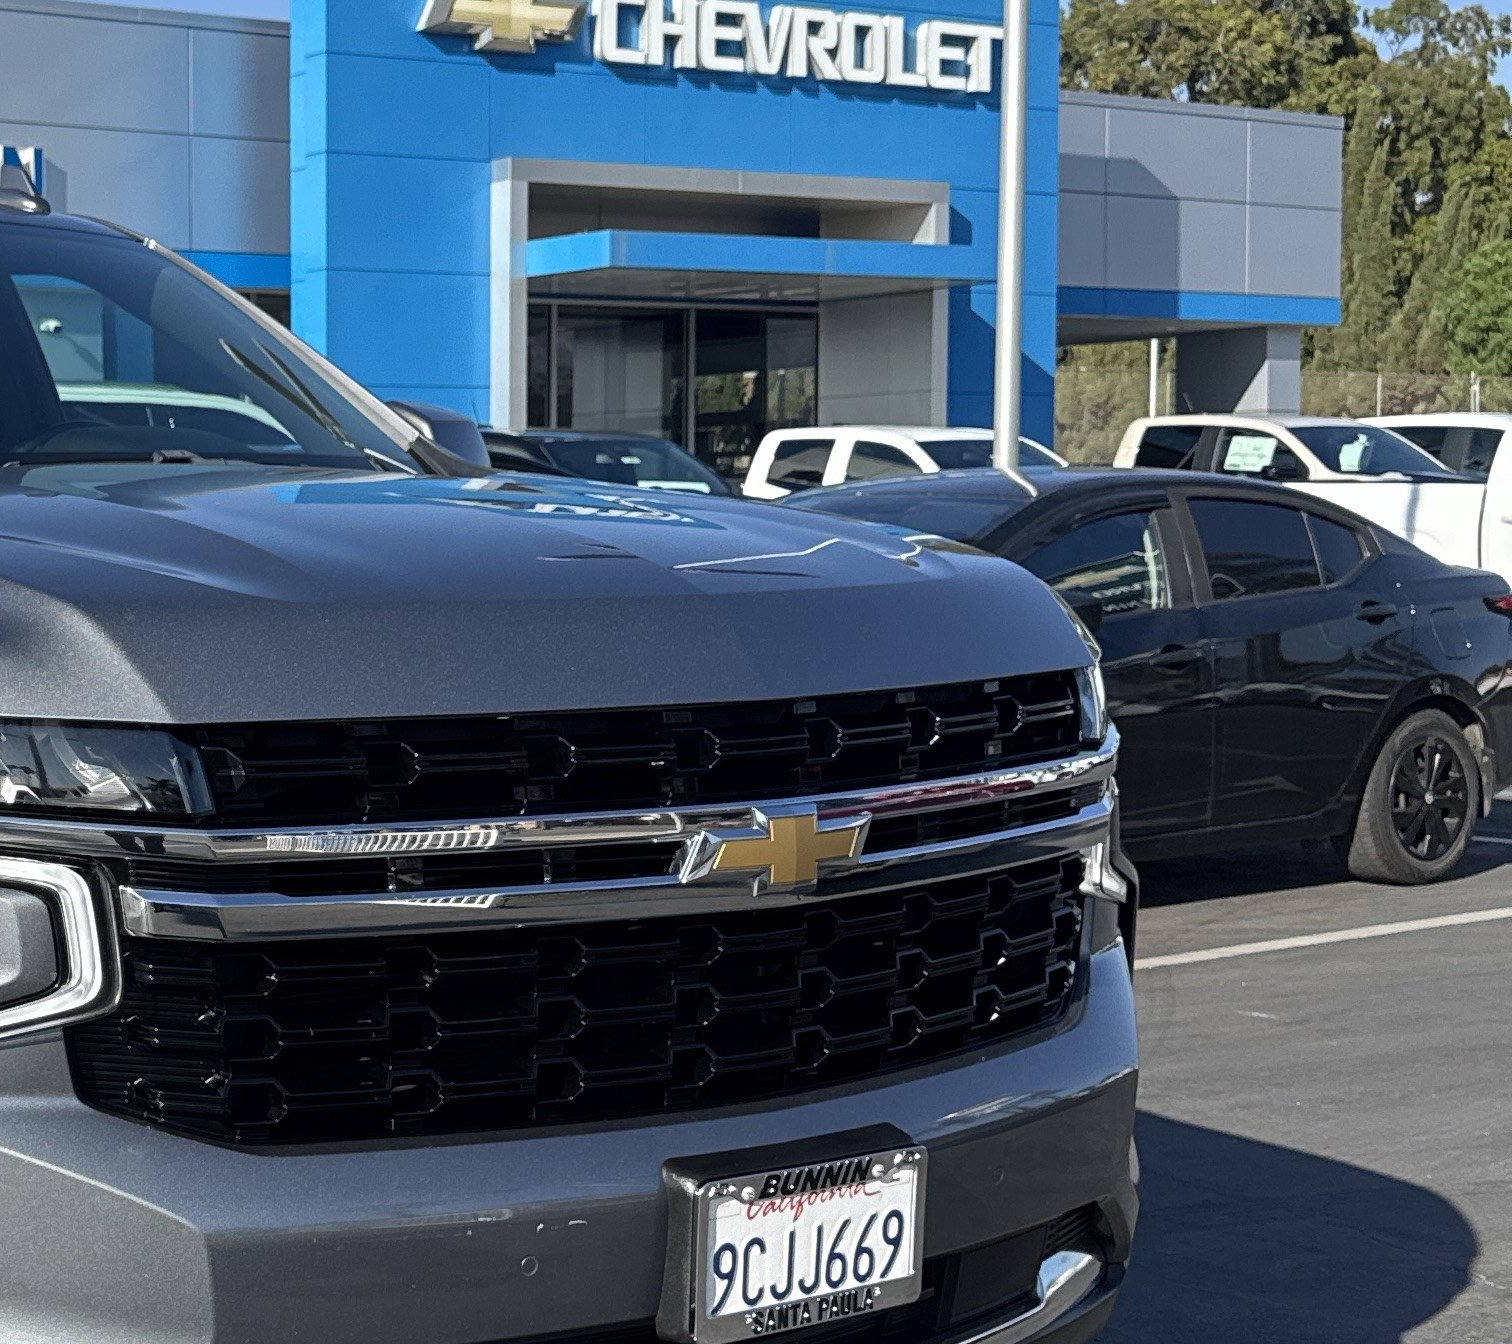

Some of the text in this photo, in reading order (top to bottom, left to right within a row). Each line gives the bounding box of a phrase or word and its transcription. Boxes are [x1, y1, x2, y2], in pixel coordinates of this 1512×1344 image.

[758, 1156, 873, 1200] BUNNIN
[709, 1208, 905, 1316] 9CJJ669
[751, 1288, 875, 1335] SANTA PAULA
